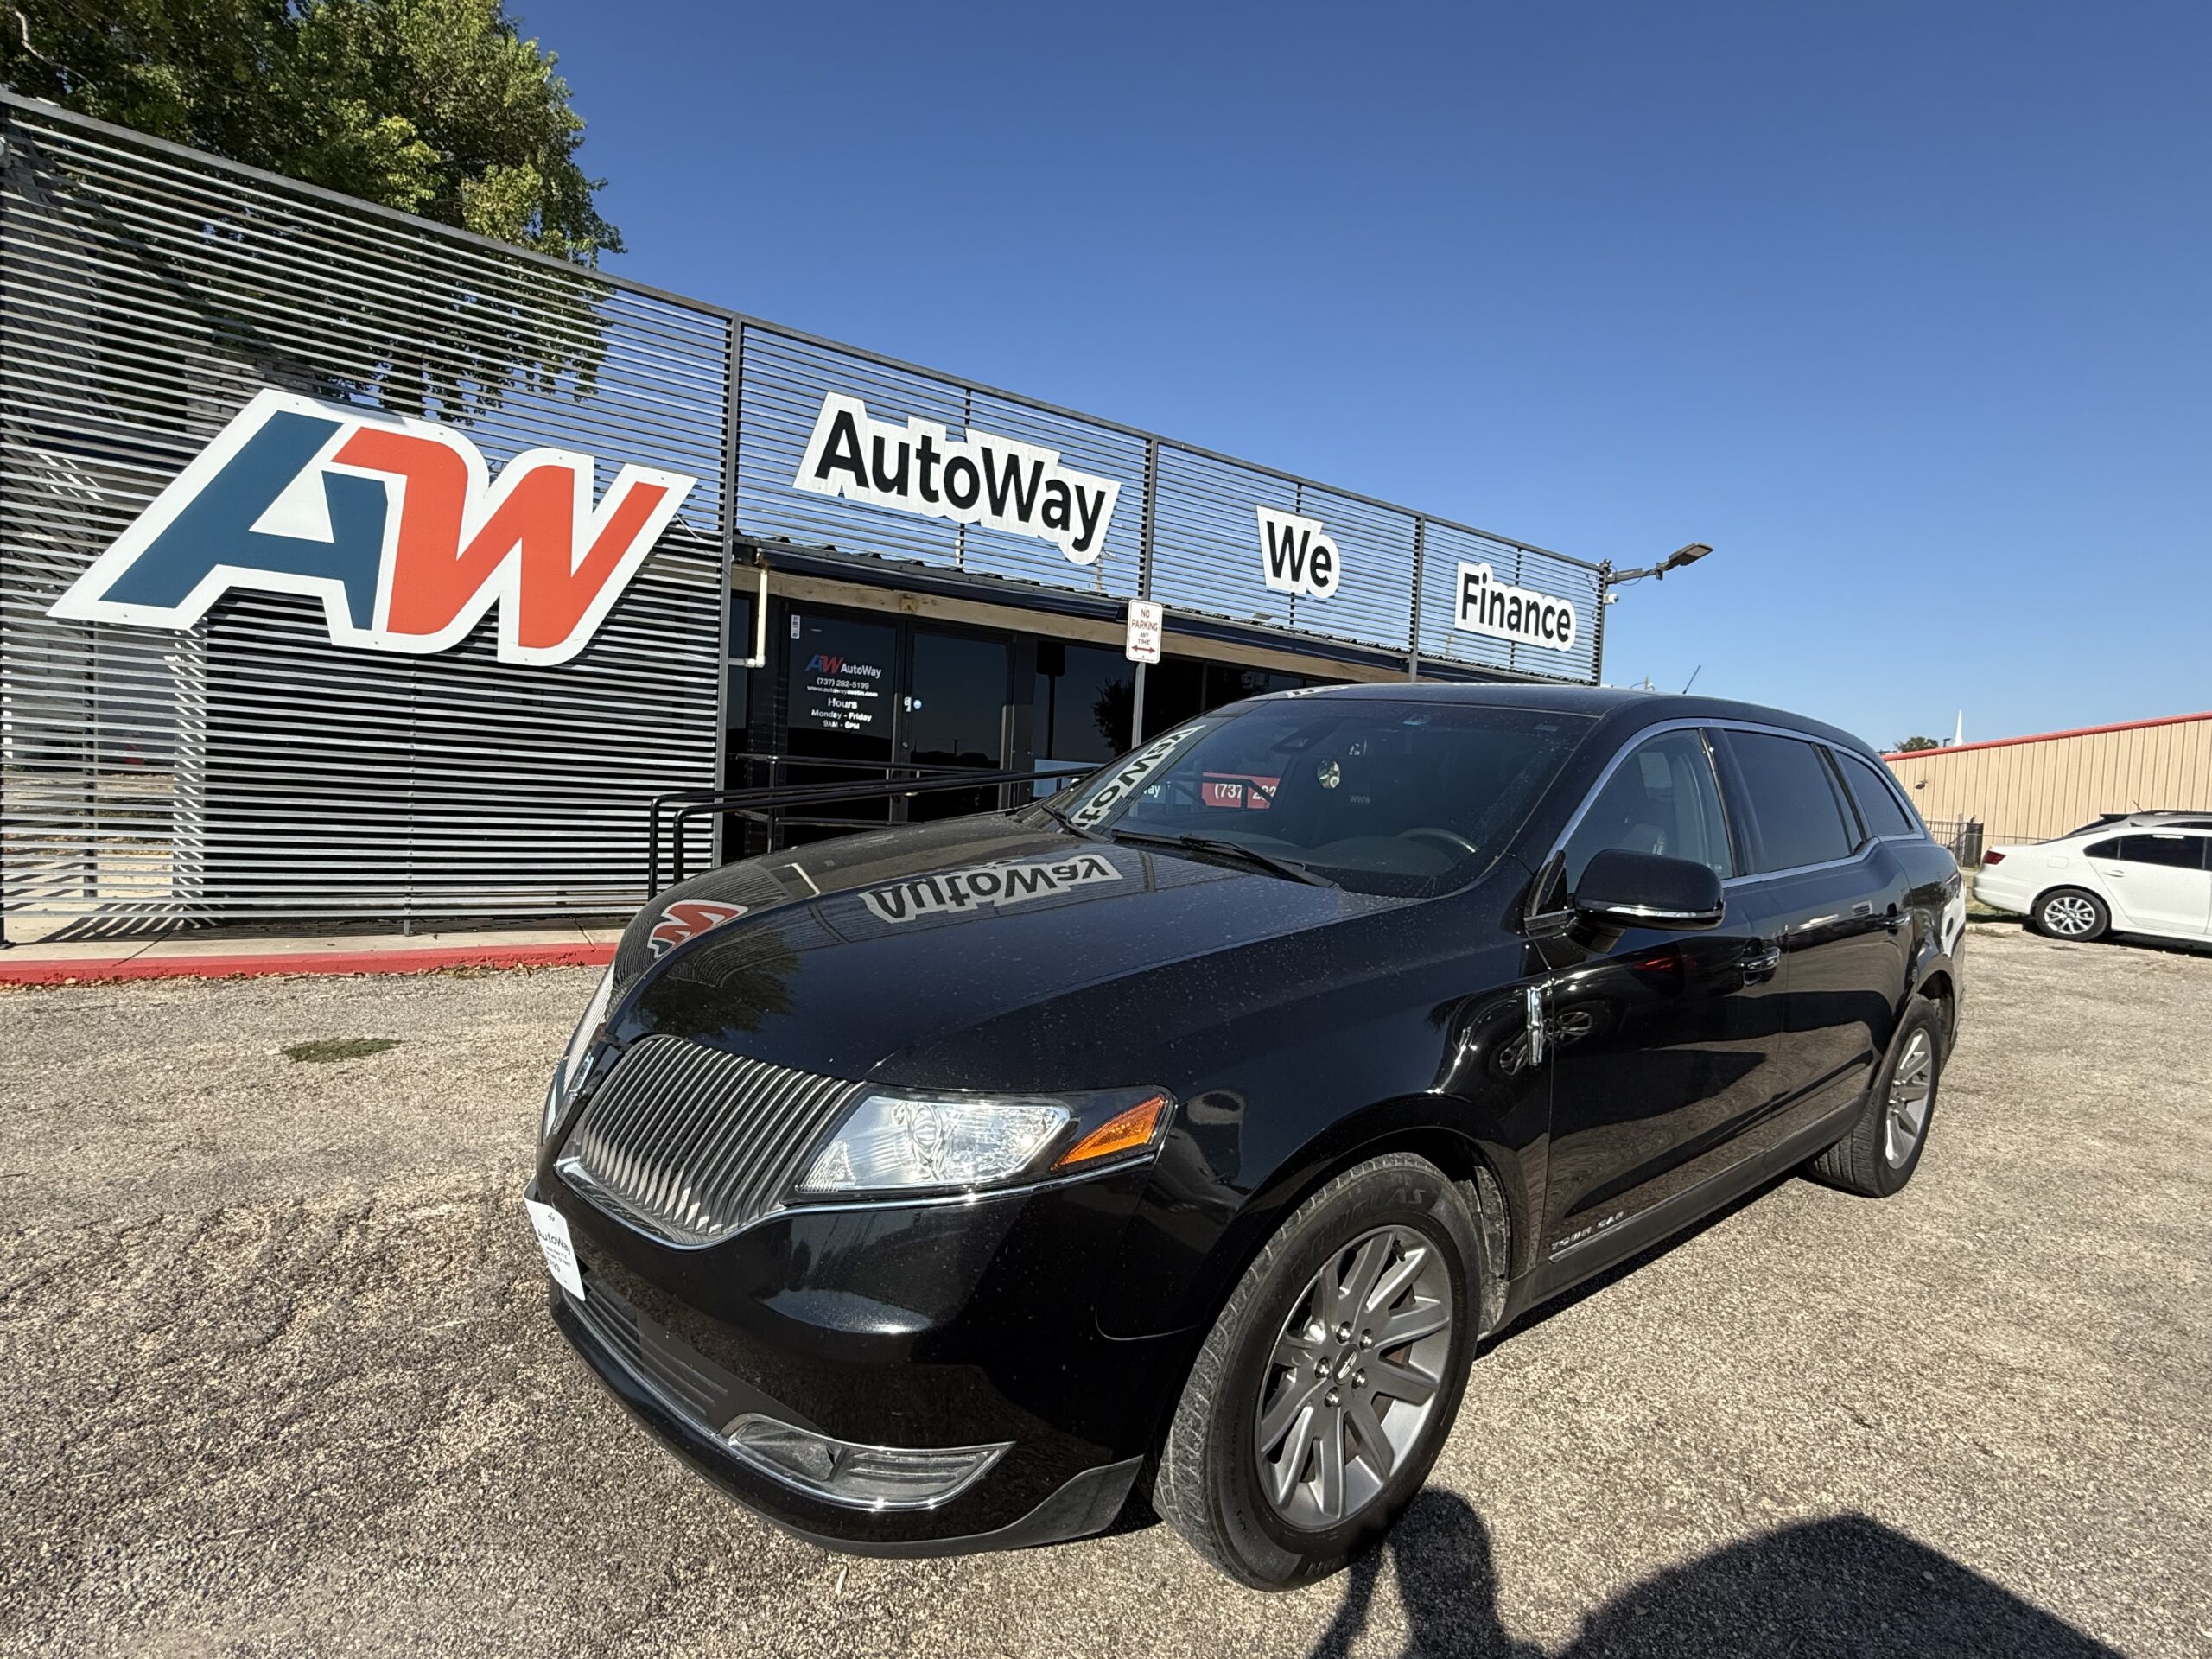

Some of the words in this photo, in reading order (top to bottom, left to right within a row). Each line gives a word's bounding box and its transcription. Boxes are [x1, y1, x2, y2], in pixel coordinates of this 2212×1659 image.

[814, 410, 1107, 553] AutoWay
[99, 410, 669, 649] AW
[1266, 520, 1332, 588] We
[1460, 571, 1572, 643] Finance
[1141, 608, 1150, 619] NO
[1131, 619, 1158, 632] PARKING
[804, 654, 843, 673] AW
[841, 664, 882, 679] AutoWay
[817, 677, 835, 686] (737)
[836, 680, 870, 690] 282-5199
[827, 697, 858, 709] Hours
[810, 709, 842, 720] Monday
[848, 712, 873, 723] Friday
